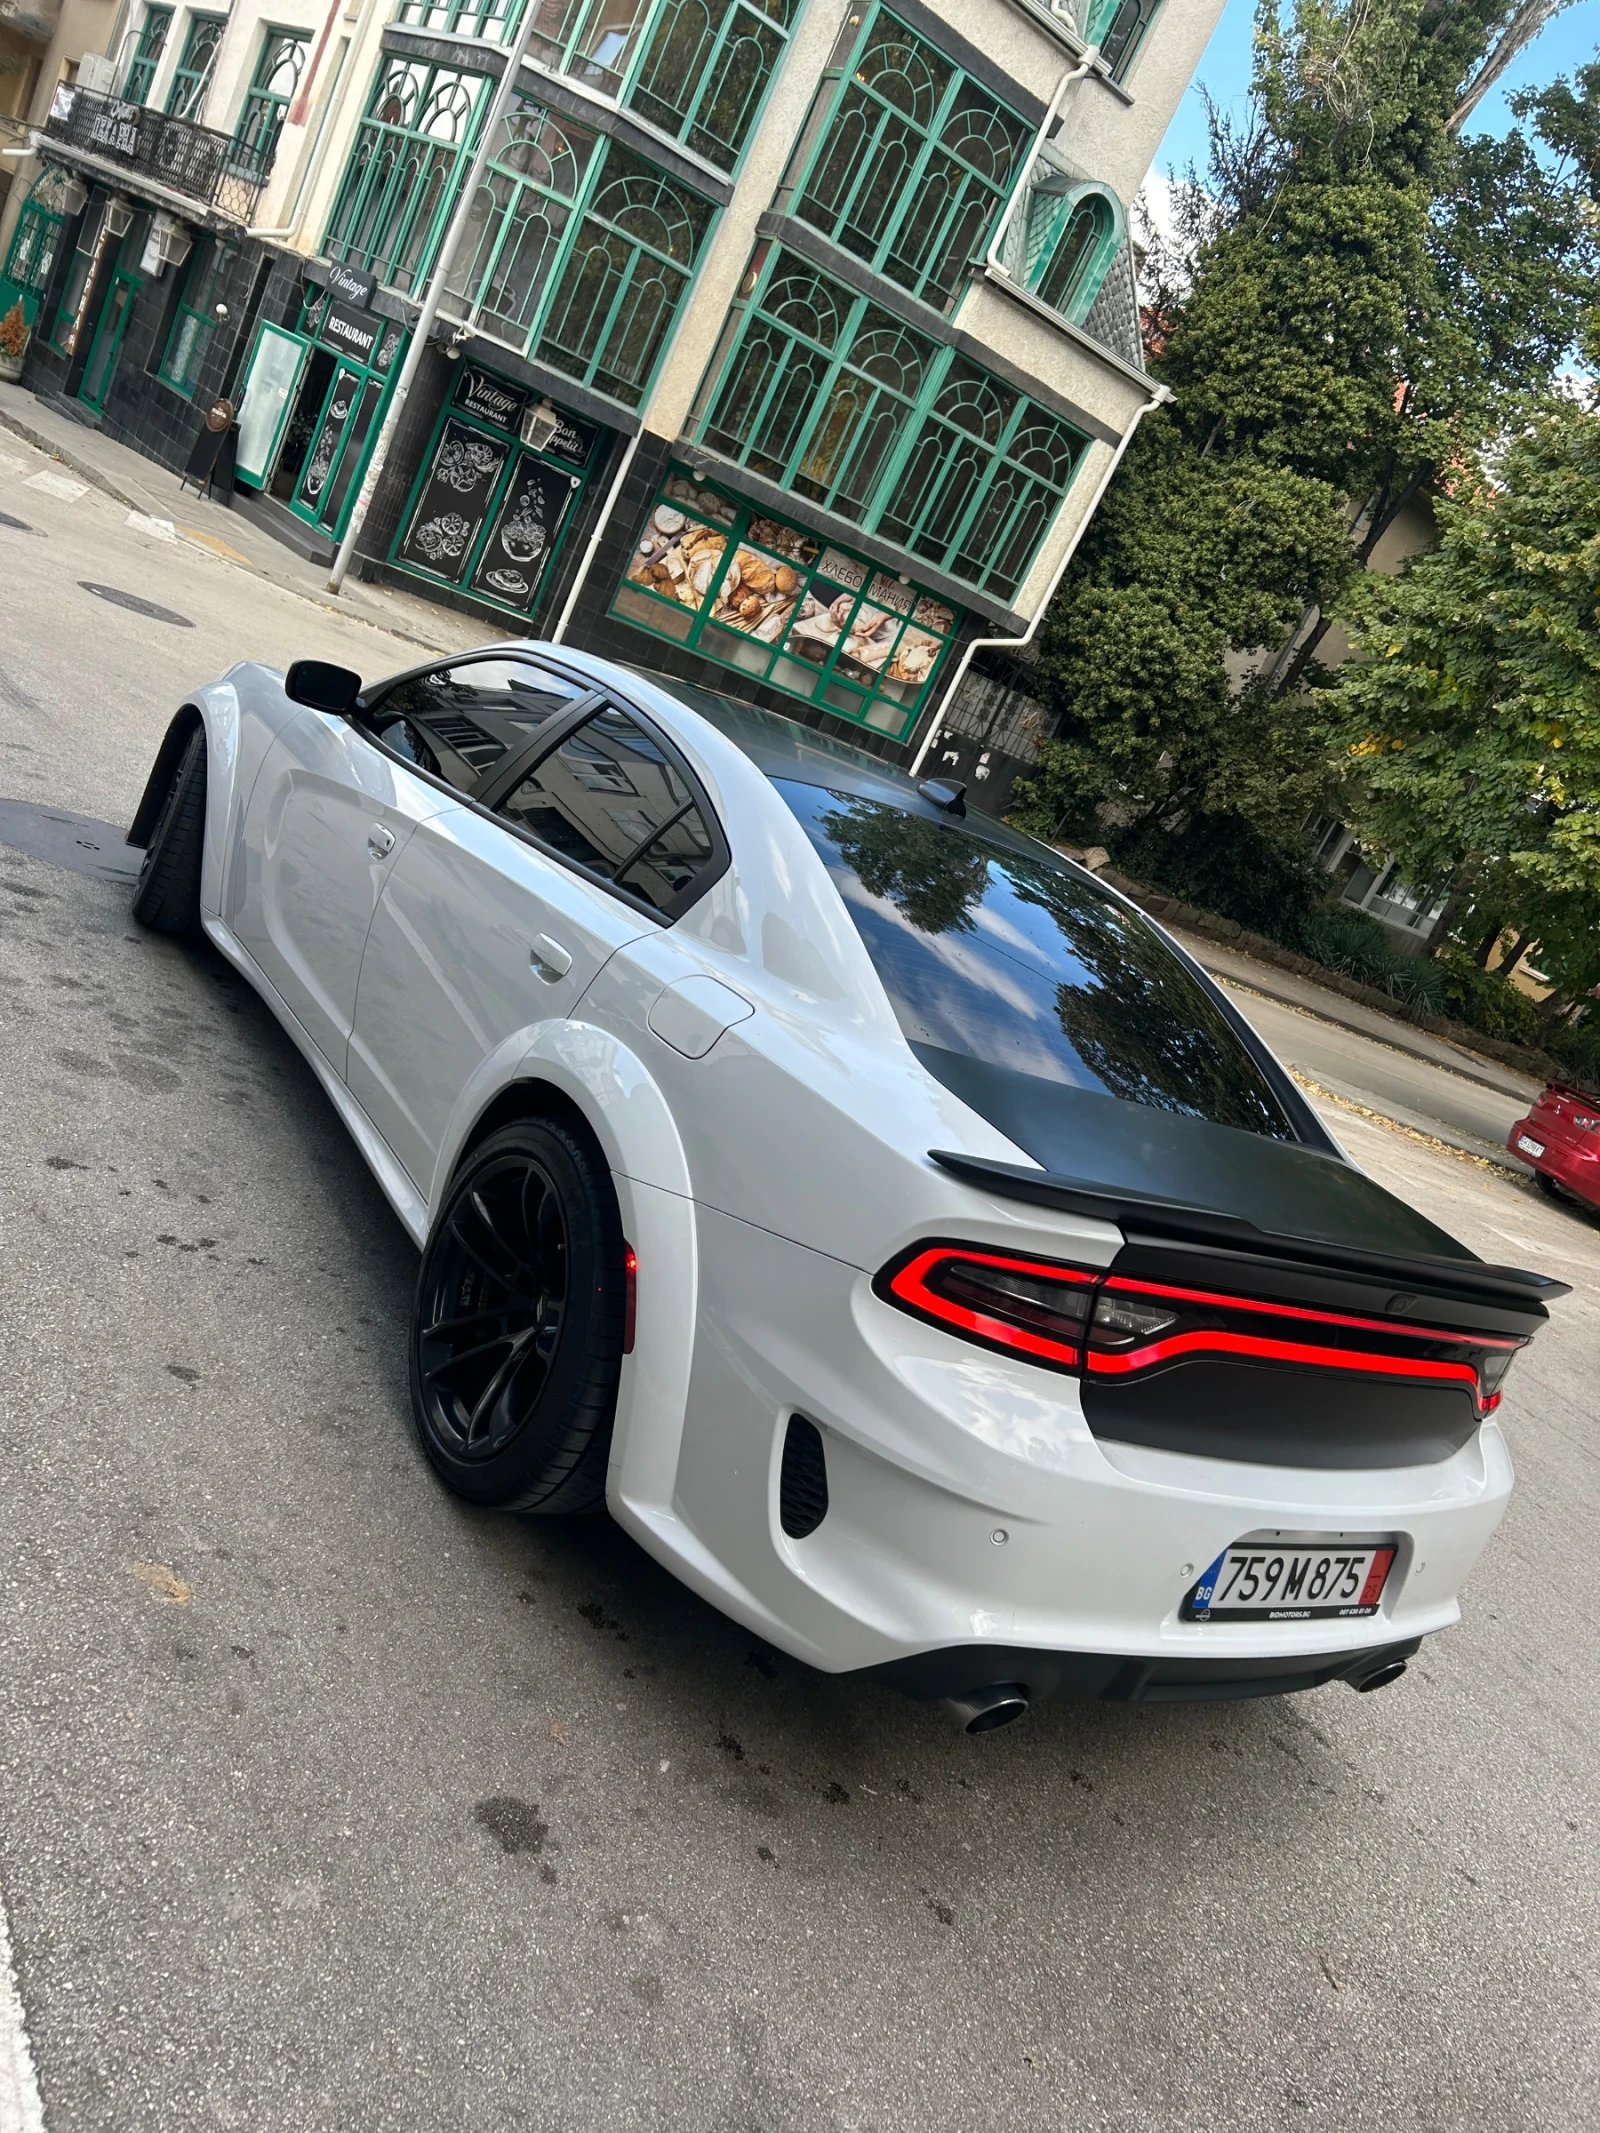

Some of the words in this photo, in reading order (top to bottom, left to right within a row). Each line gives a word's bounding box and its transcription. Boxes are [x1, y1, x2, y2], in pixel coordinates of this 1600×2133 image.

[73, 224, 106, 330] ЕКАРНА
[329, 266, 368, 300] Vintage
[328, 316, 374, 350] RESTAURANT
[464, 371, 517, 412] Vintage
[464, 398, 507, 423] RESTAURANT
[555, 419, 577, 439] Bon
[821, 560, 863, 588] ХЛЕБО
[868, 582, 913, 611] МАНИЯ
[1195, 1586, 1213, 1600] BG
[1218, 1556, 1366, 1601] 759M875
